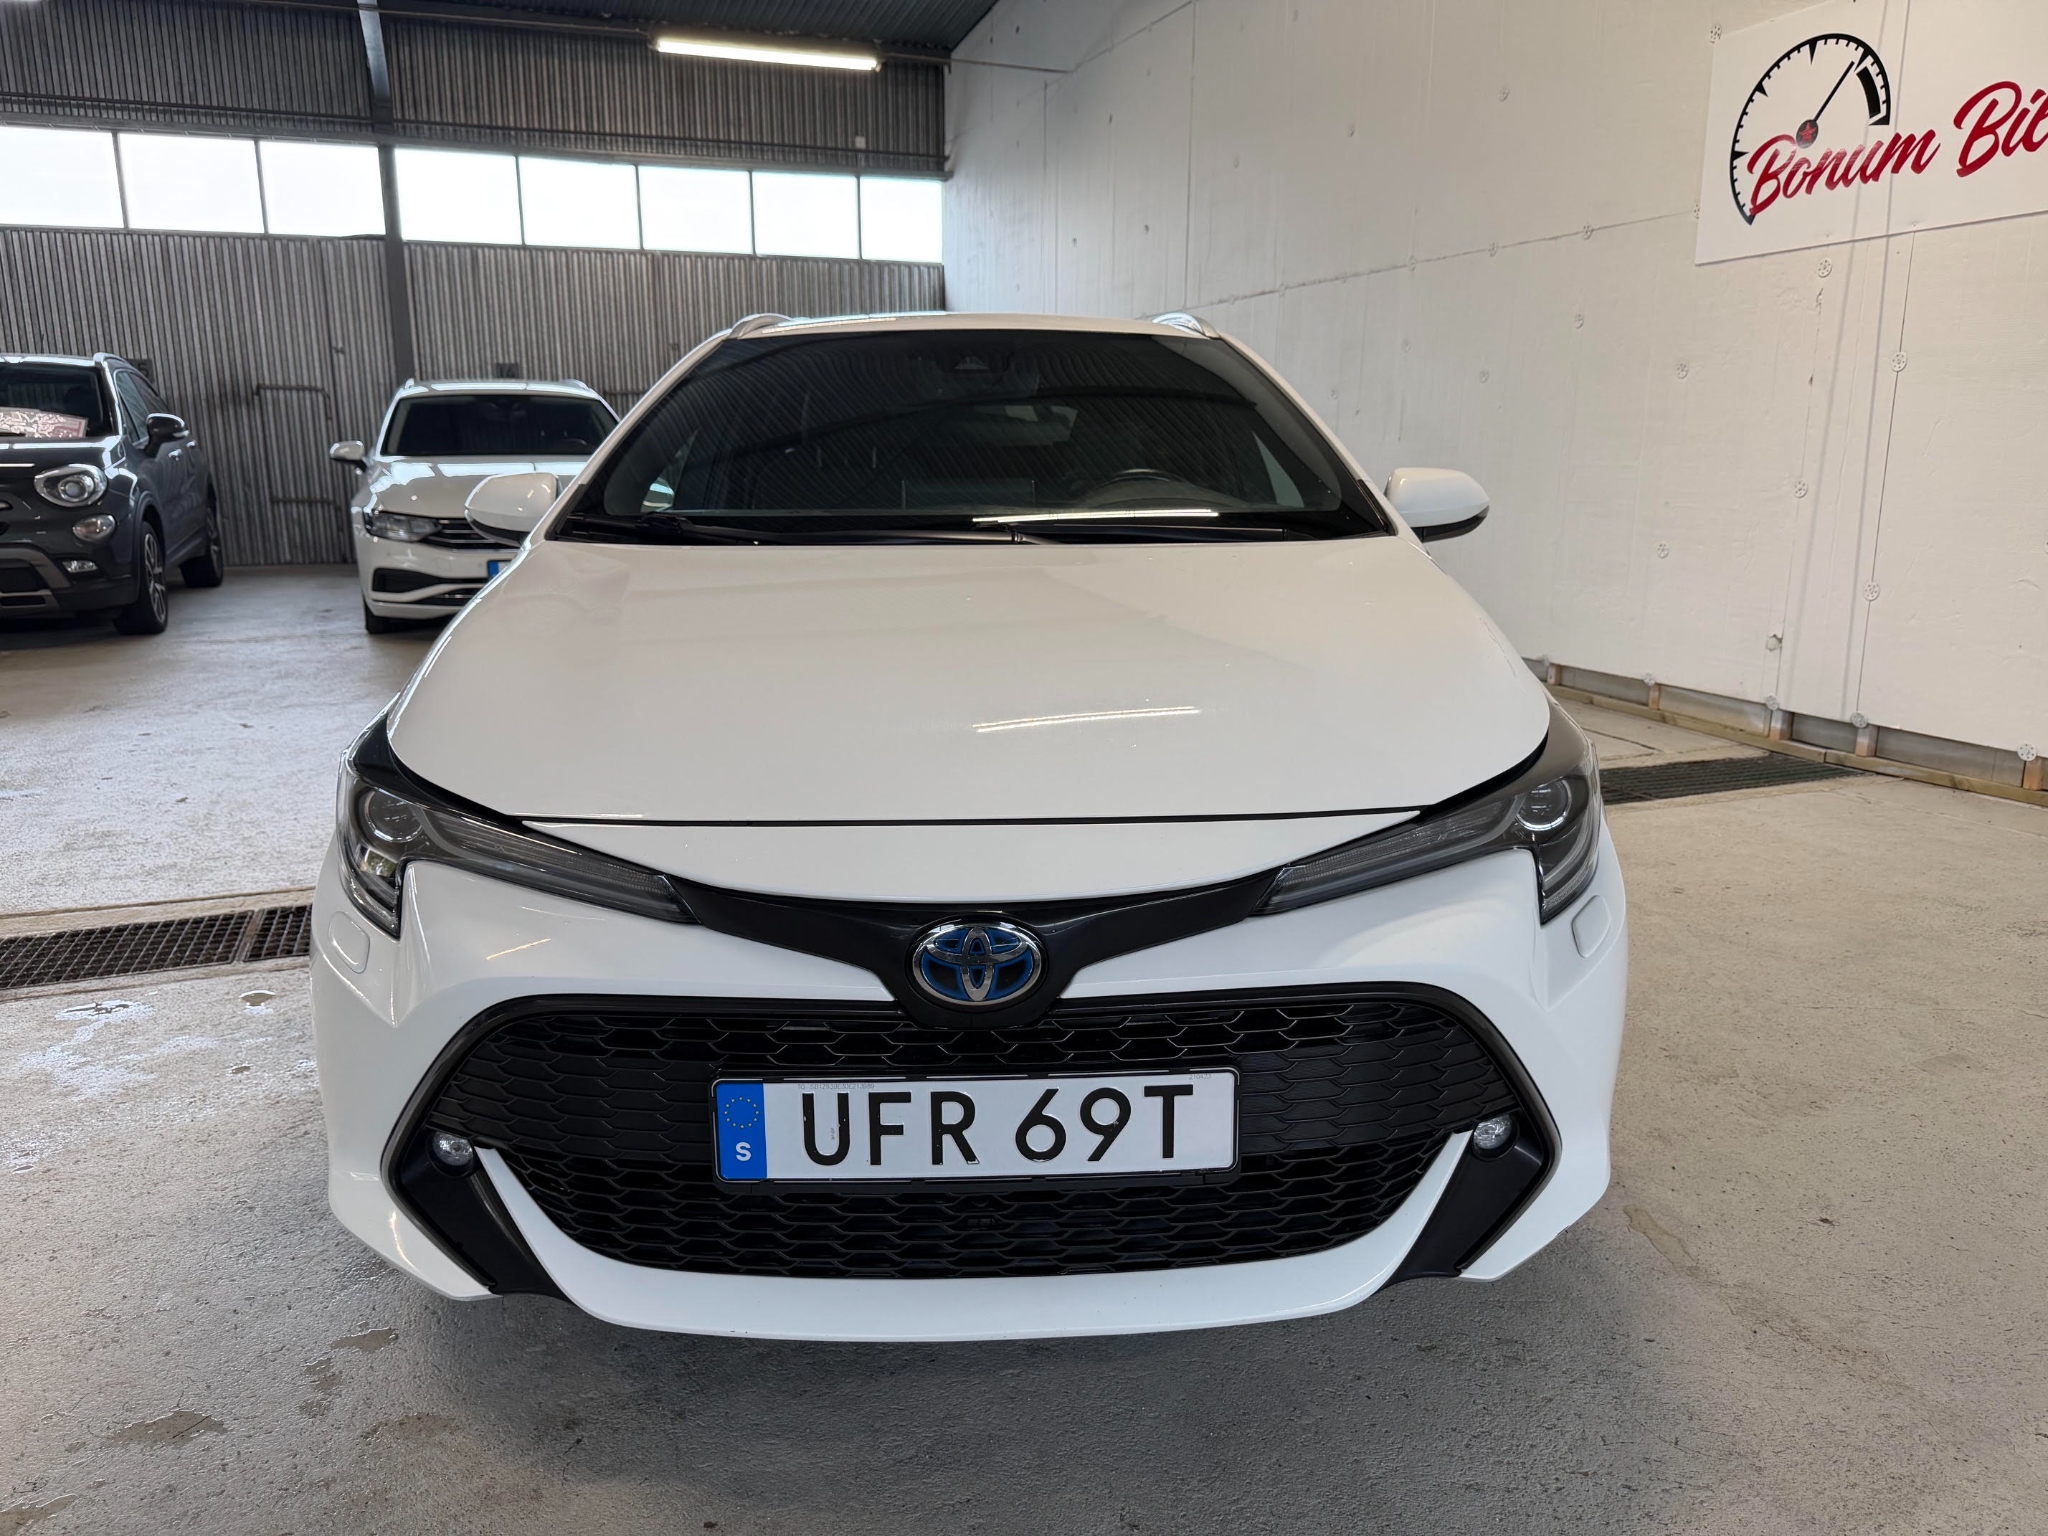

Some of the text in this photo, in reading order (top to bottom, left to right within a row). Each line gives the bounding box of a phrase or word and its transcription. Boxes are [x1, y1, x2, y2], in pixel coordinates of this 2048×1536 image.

[1747, 129, 1941, 217] Bonum
[735, 1141, 752, 1162] S
[802, 1085, 1194, 1166] UFR 69T
